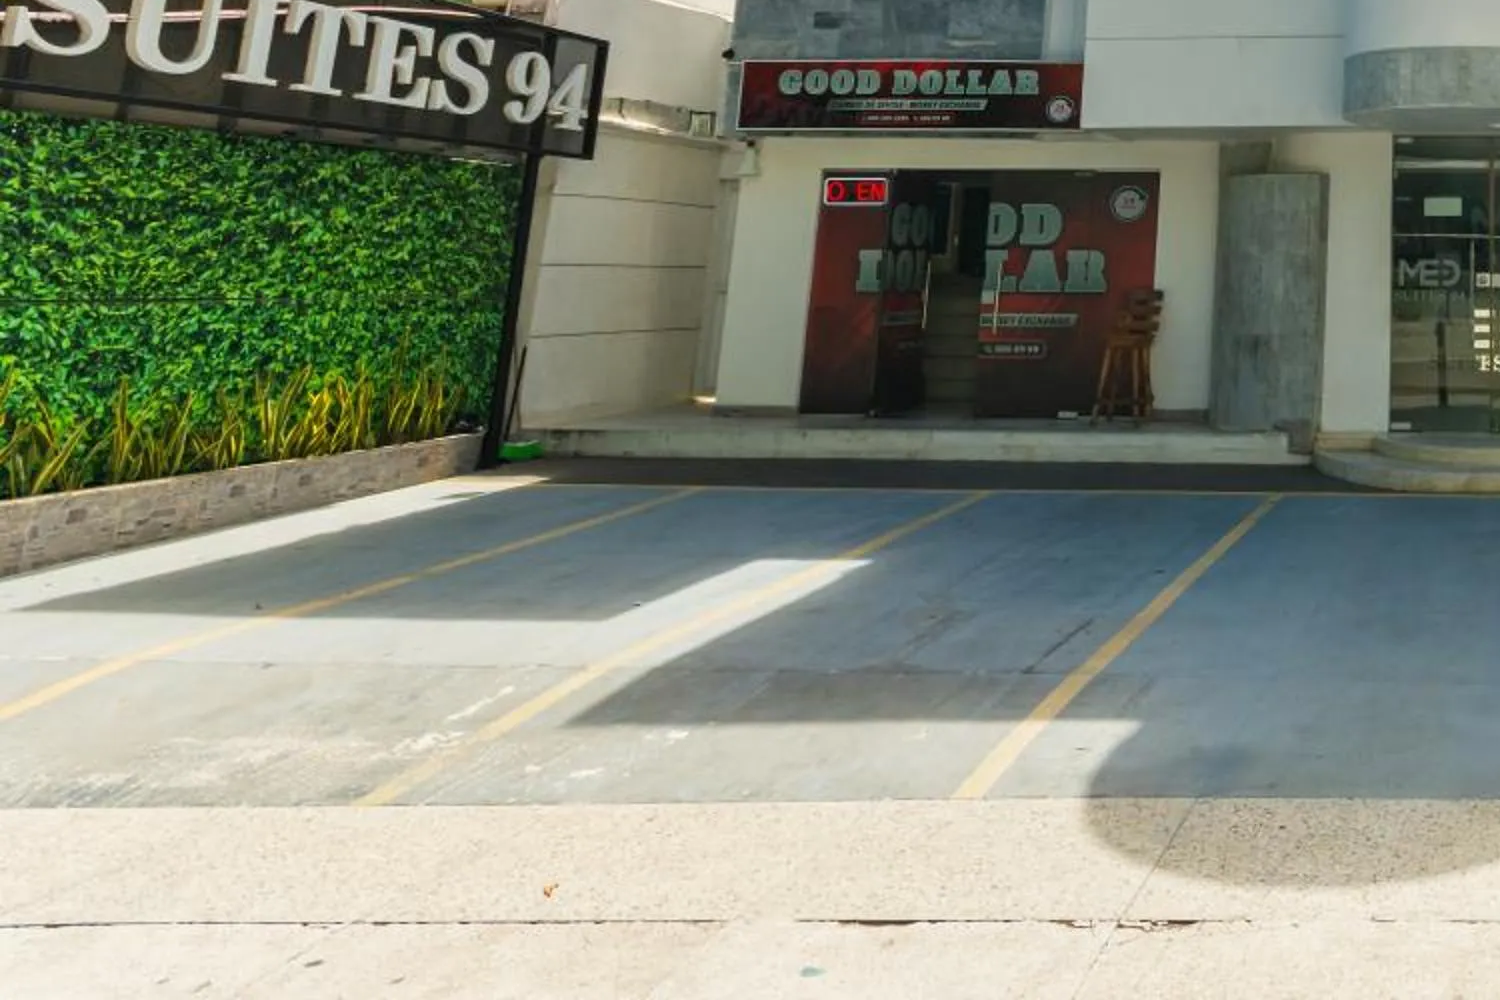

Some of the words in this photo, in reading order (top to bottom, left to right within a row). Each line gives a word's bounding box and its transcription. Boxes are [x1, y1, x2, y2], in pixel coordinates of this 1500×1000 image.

[505, 50, 590, 132] 94
[778, 69, 881, 96] GOOD
[891, 69, 1040, 96] DOLLAR
[828, 181, 886, 201] OEN
